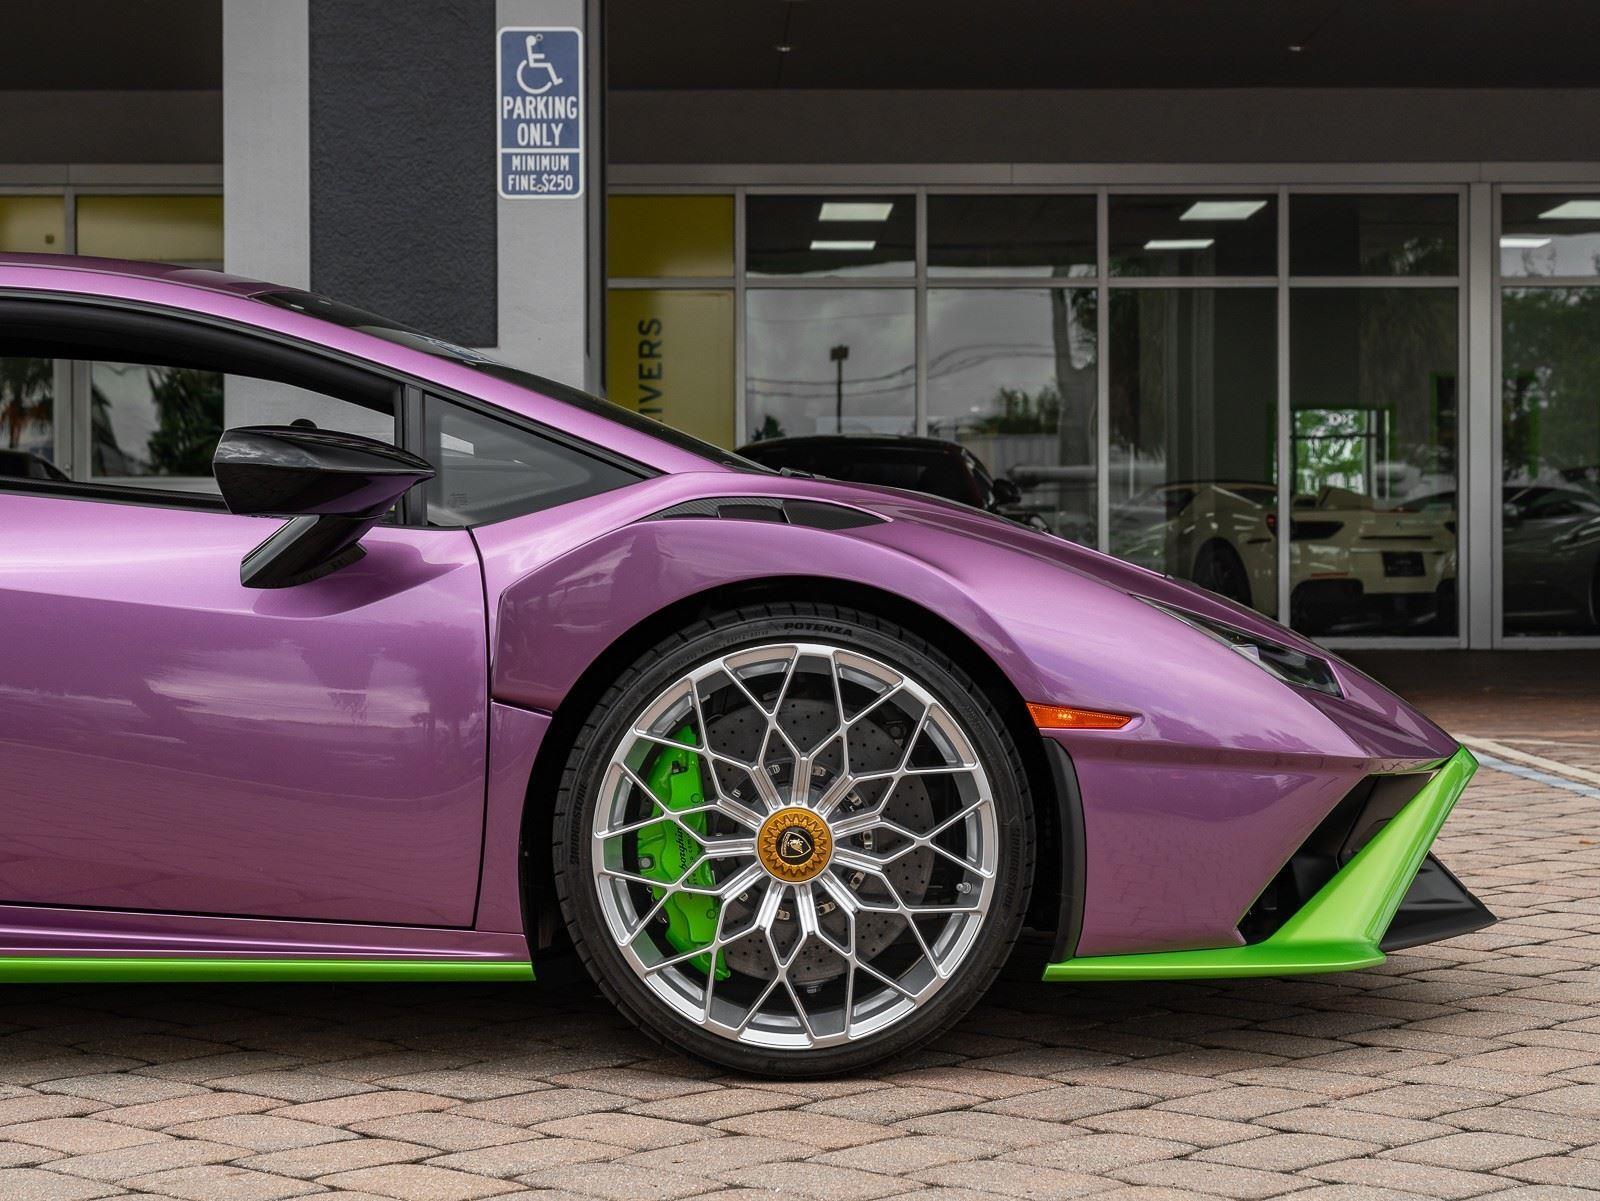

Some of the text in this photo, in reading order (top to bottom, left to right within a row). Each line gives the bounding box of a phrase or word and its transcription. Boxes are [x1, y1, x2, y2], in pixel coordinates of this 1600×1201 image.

[503, 96, 577, 119] PARKING
[517, 123, 563, 146] ONLY
[512, 155, 569, 171] MINIMUM
[508, 173, 573, 192] FINE $250
[638, 318, 662, 418] IVERS
[783, 622, 852, 637] POTENZA
